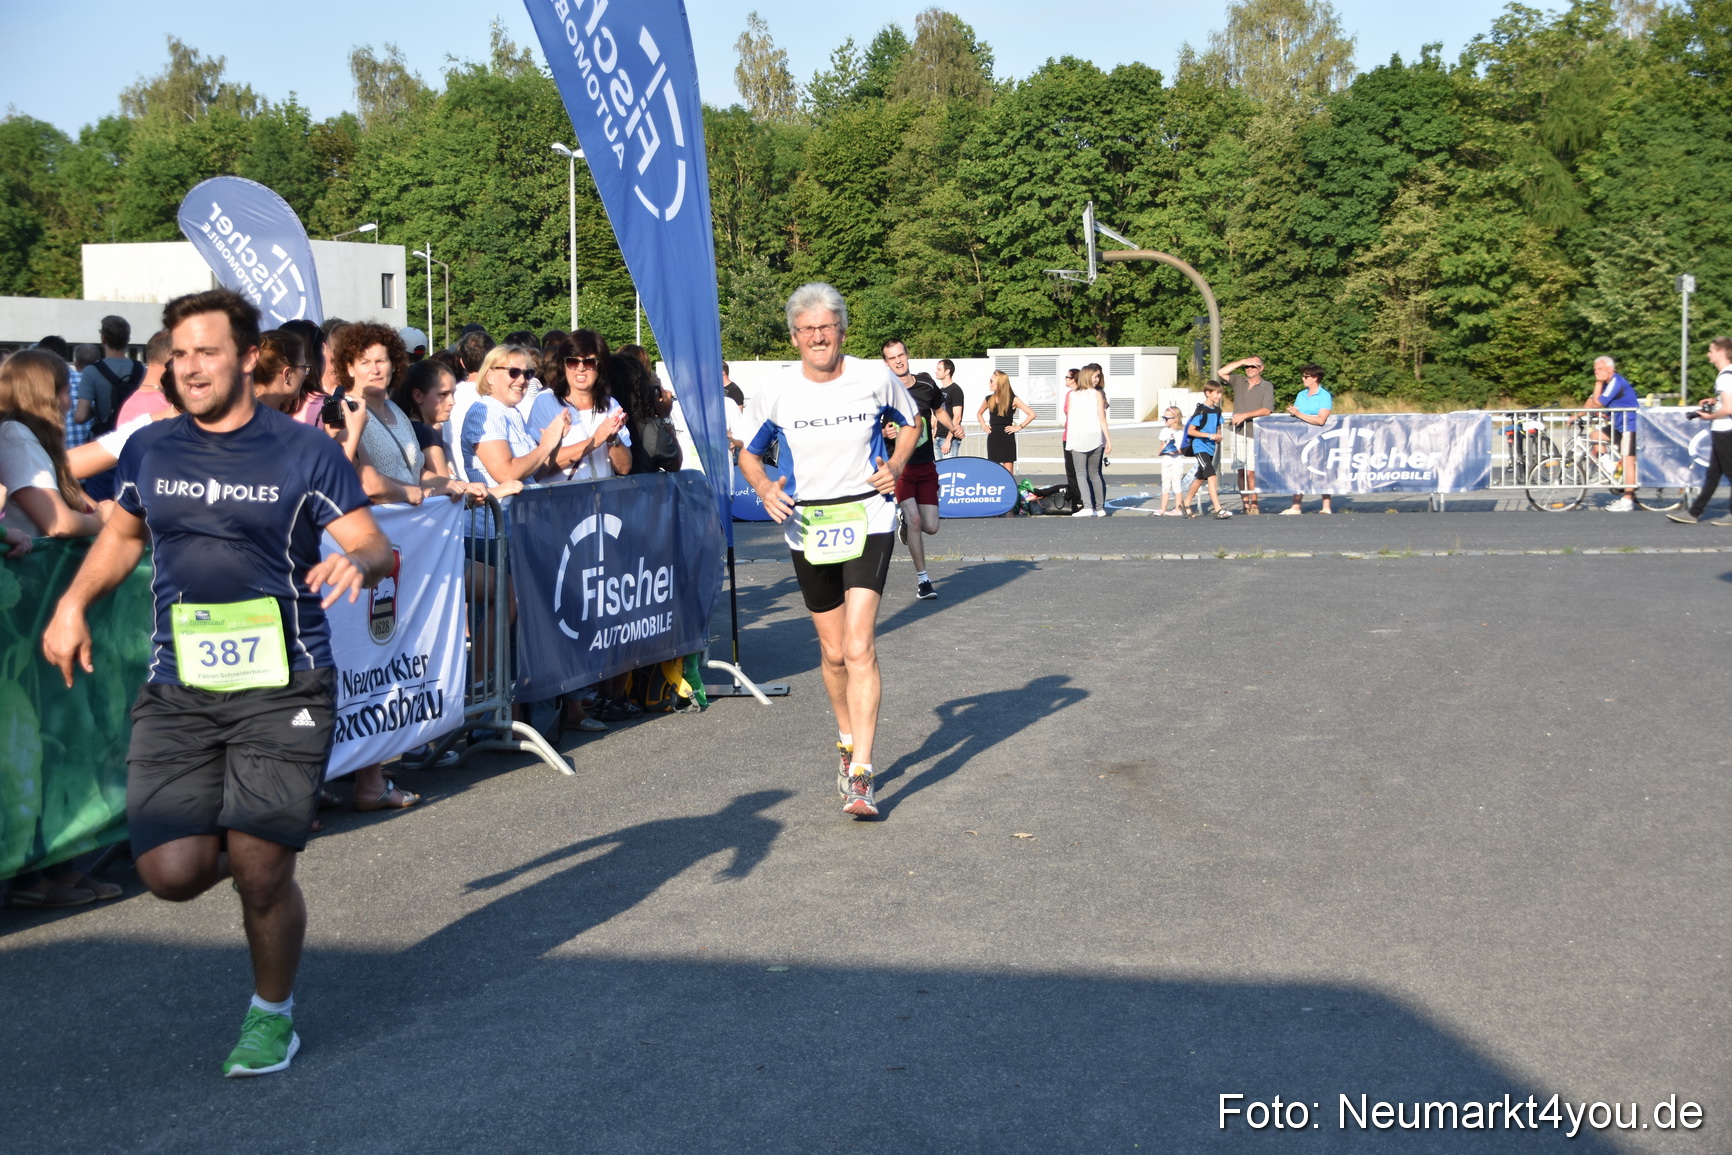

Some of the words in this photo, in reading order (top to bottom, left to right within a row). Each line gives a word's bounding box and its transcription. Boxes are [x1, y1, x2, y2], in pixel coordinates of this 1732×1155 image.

[794, 413, 867, 429] DELPHI
[1326, 446, 1442, 469] Fischer
[1337, 471, 1432, 481] AUTOMOBILE
[156, 479, 206, 498] EURO
[223, 484, 280, 502] POLES
[940, 483, 1006, 498] Fischer
[947, 496, 1002, 505] AUTOMOBILE
[815, 526, 855, 548] 279
[374, 619, 391, 636] 1628
[588, 610, 673, 652] AUTOMOBILE
[198, 636, 261, 667] 387
